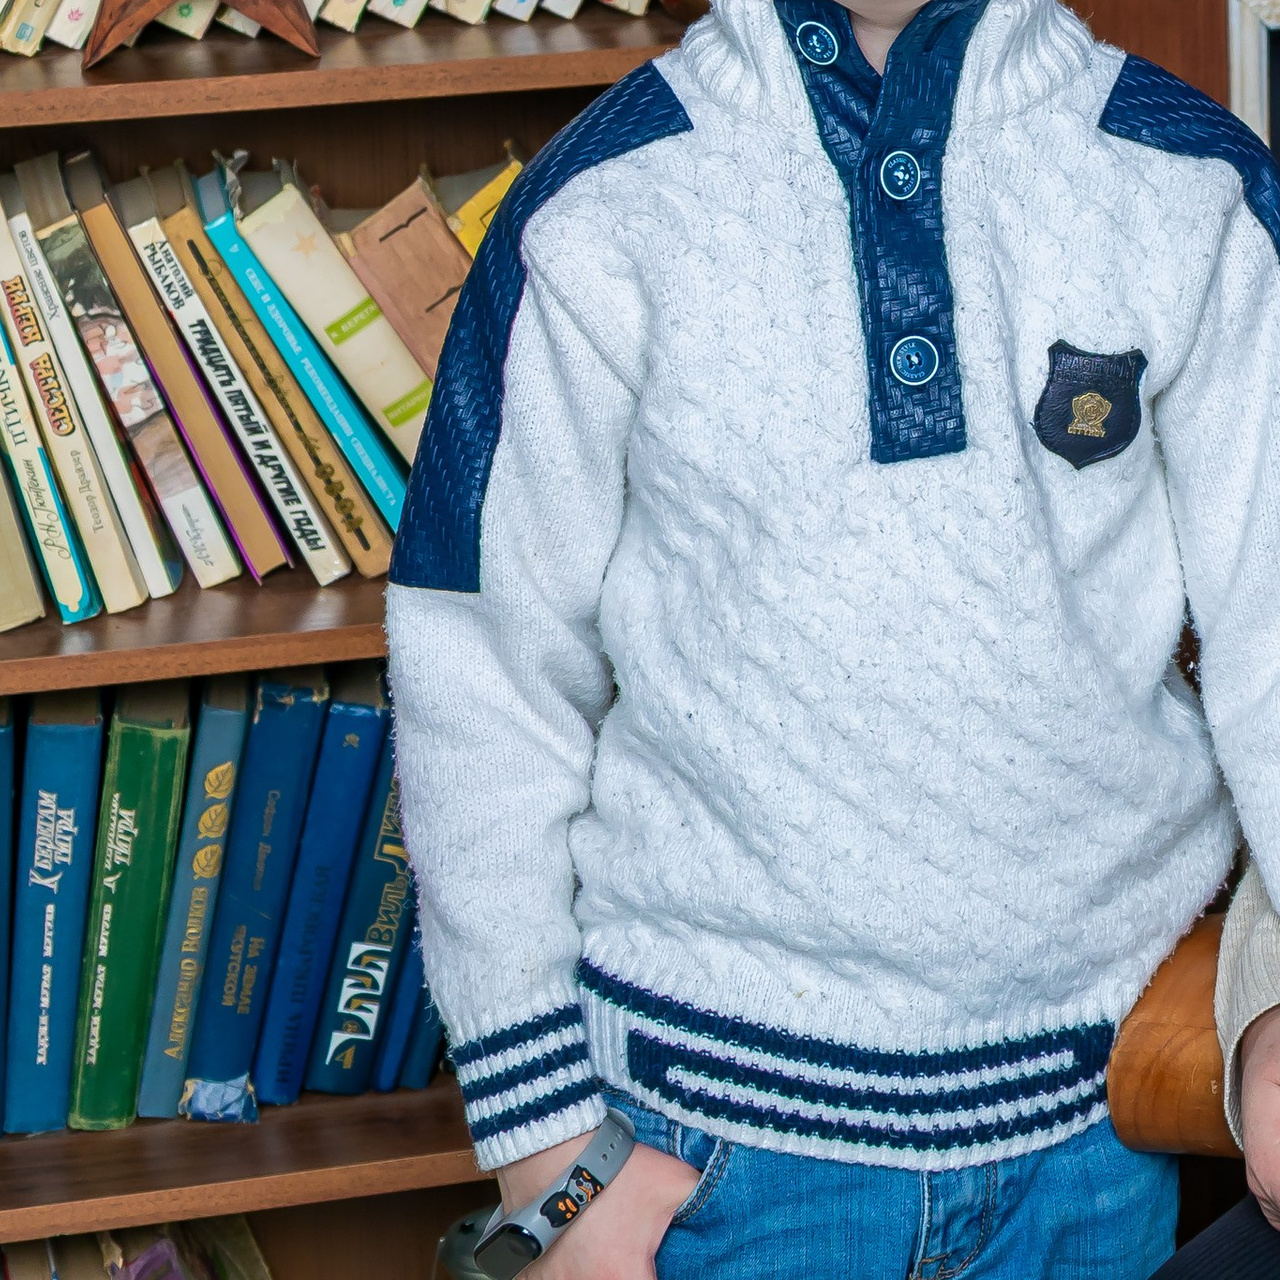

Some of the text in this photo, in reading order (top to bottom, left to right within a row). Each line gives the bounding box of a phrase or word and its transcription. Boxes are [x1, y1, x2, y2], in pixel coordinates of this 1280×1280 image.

[143, 243, 186, 311] РЫБАКОВ
[156, 239, 195, 299] Анатолий
[1, 275, 45, 347] КЕРРИ
[29, 351, 76, 437] СЕСТРА
[187, 318, 326, 552] ТРИДЦАТЬ ПЯТЫЙ И ДРУГИЕ ГОДЫ
[34, 789, 58, 871] БЕРЕГАМ
[54, 807, 79, 866] ТИГРА
[115, 809, 139, 867] ТИГРА
